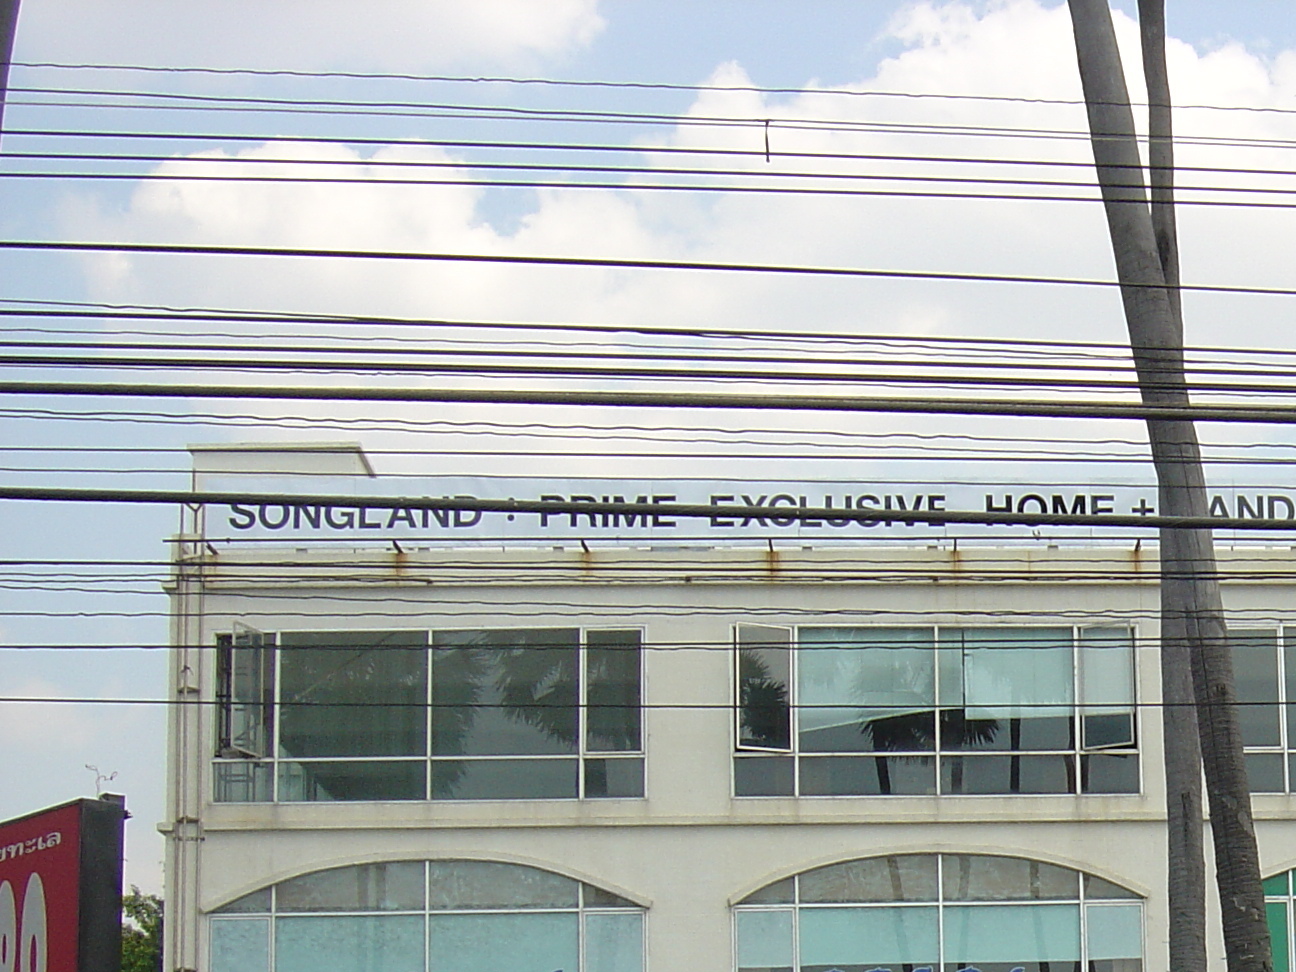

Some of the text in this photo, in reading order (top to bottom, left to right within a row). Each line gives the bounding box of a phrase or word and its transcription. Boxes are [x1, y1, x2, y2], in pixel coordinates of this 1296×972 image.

[229, 496, 483, 530] SONGLAND
[540, 494, 677, 528] PRIME
[709, 494, 947, 528] EXCLUSIVE
[985, 494, 1115, 525] HOME
[1208, 495, 1296, 524] AND
